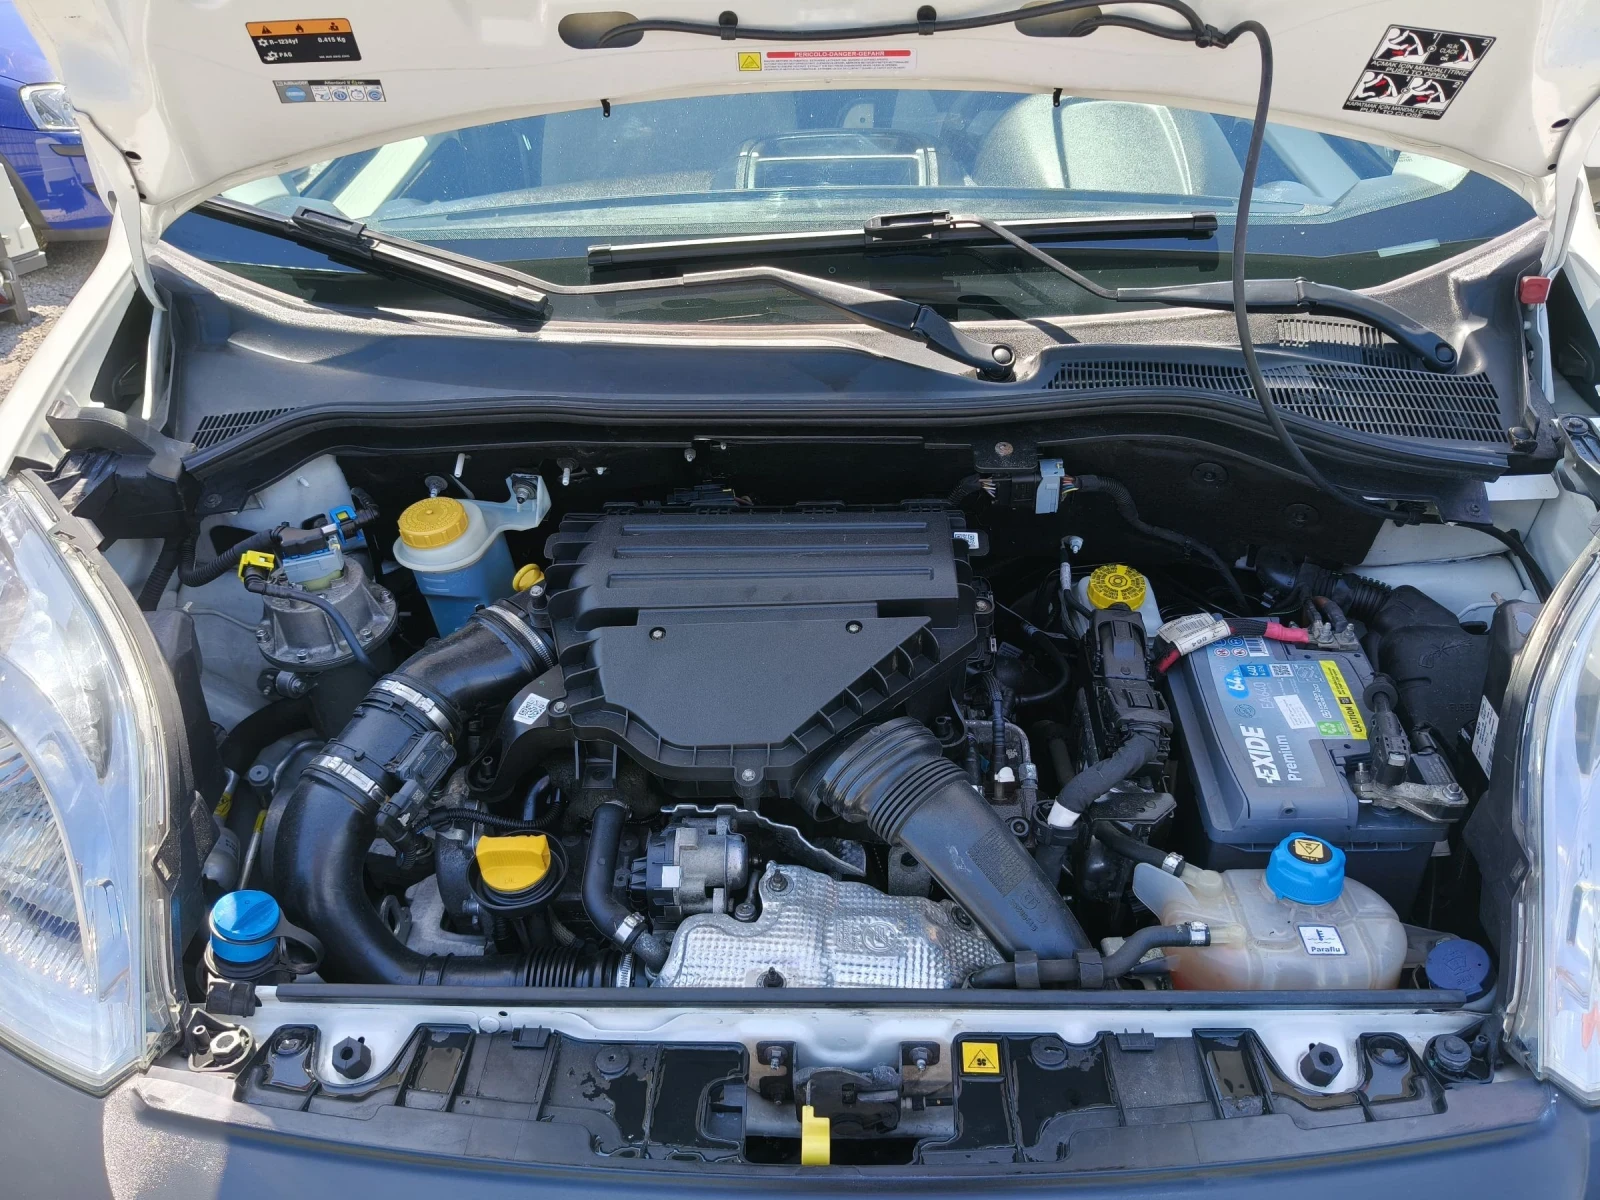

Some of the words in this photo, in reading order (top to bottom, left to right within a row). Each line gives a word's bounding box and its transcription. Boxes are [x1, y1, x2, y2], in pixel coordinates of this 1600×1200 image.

[1385, 67, 1409, 75] PUSH
[1424, 71, 1448, 79] OPEN
[1395, 111, 1424, 119] CLOSE
[1249, 665, 1259, 676] 640
[1229, 678, 1246, 692] 64
[1345, 706, 1363, 733] CAUTION
[1240, 725, 1281, 784] EXIDE
[1276, 734, 1302, 782] Premium
